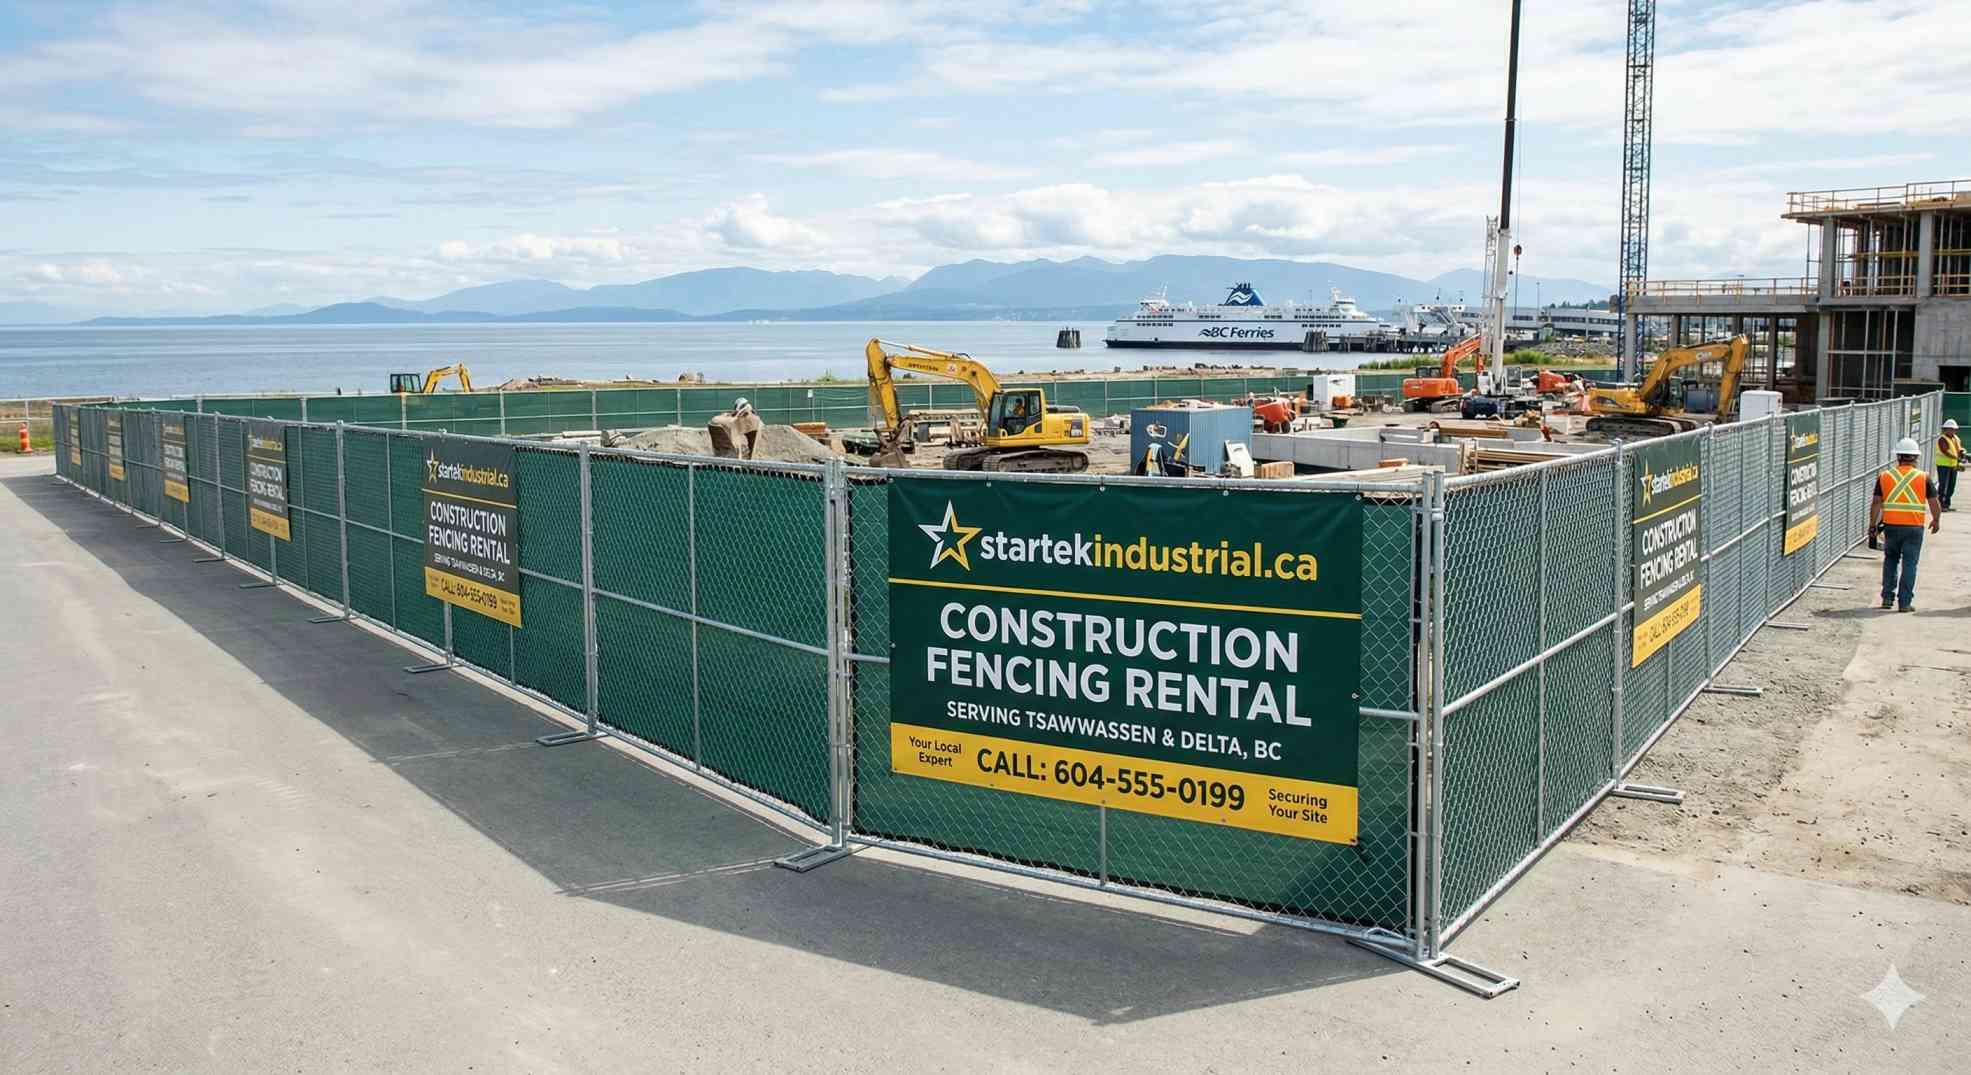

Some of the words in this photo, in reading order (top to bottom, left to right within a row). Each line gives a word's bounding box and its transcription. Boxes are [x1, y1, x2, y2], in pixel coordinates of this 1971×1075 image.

[1209, 326, 1230, 338] BC
[1230, 326, 1275, 338] Ferries
[430, 500, 507, 537] CONSTRUCTION
[1642, 508, 1697, 556] CONSTRUCTION
[428, 525, 469, 553] FENCING
[470, 534, 511, 565] RENTAL
[980, 532, 1318, 582] startekindustrial.ca
[940, 601, 1299, 673] CONSTRUCTION
[927, 646, 1111, 704] FENCING
[1125, 667, 1313, 728] RENTAL
[909, 735, 931, 751] Your
[934, 738, 962, 755] Local
[946, 700, 1022, 727] SERVING
[1025, 710, 1156, 746] TSAWWASSEN
[1162, 729, 1175, 747] &
[1180, 731, 1248, 760] DELTA,
[1255, 740, 1282, 761] BC
[918, 751, 953, 769] Expert
[976, 748, 1047, 782] CALL:
[1054, 760, 1246, 811] 604-555-0199
[1268, 788, 1328, 810] Securing
[1268, 804, 1295, 822] Your
[1299, 806, 1328, 825] Site
